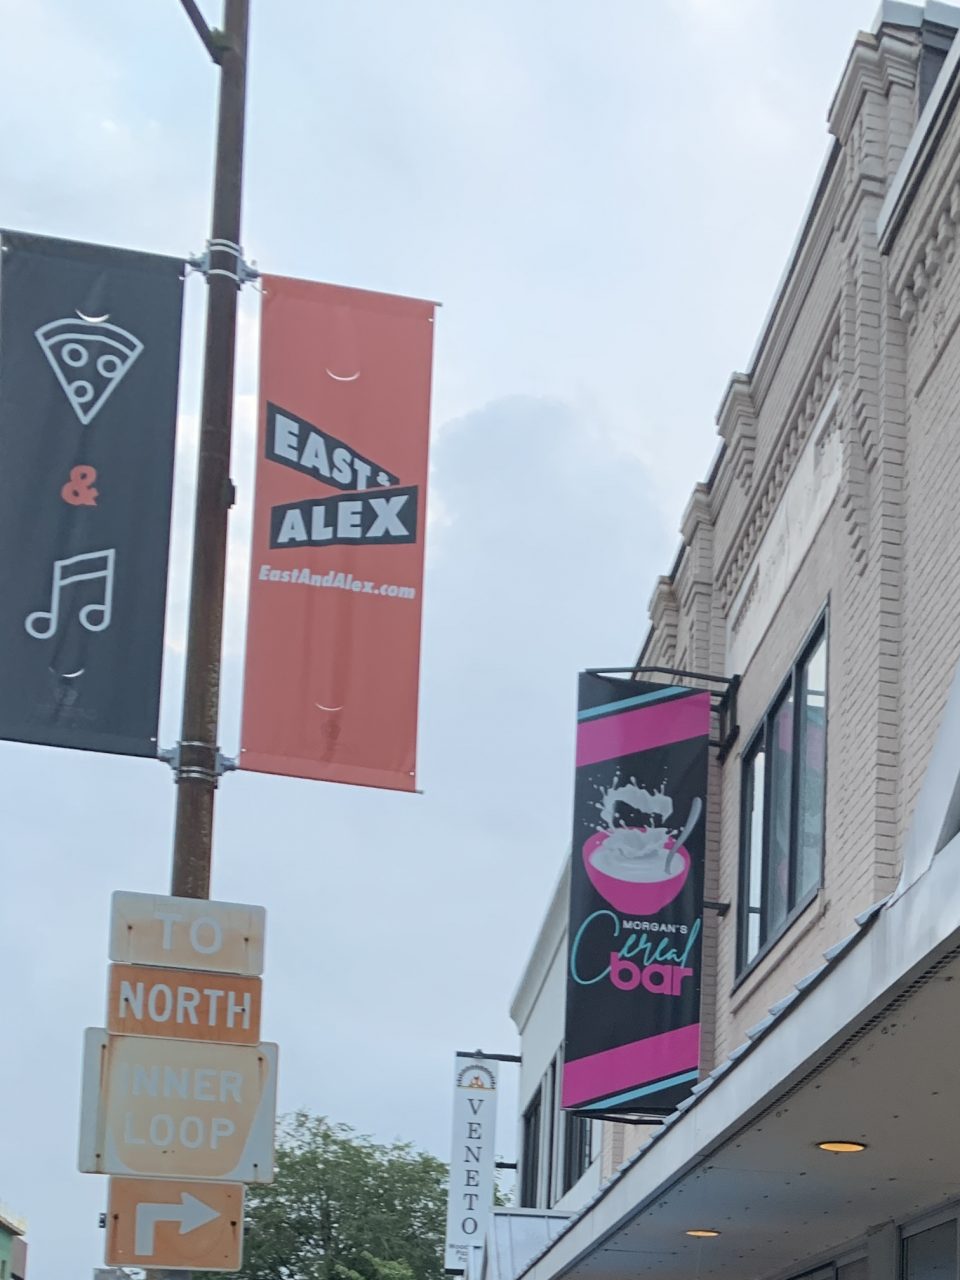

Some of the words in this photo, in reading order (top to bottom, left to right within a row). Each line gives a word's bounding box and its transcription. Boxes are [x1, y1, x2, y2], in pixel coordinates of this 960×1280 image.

[274, 413, 371, 491] EAST
[61, 464, 99, 506] &
[277, 495, 410, 543] ALEX
[258, 565, 416, 600] EastAndAlex.com
[154, 911, 225, 956] TO
[570, 909, 701, 985] Cereal
[622, 919, 688, 934] MORGAN'S
[609, 951, 693, 997] bar
[118, 980, 251, 1030] NORTH
[122, 1062, 243, 1105] INNER
[123, 1111, 237, 1151] LOOP
[461, 1098, 485, 1235] VENETO
